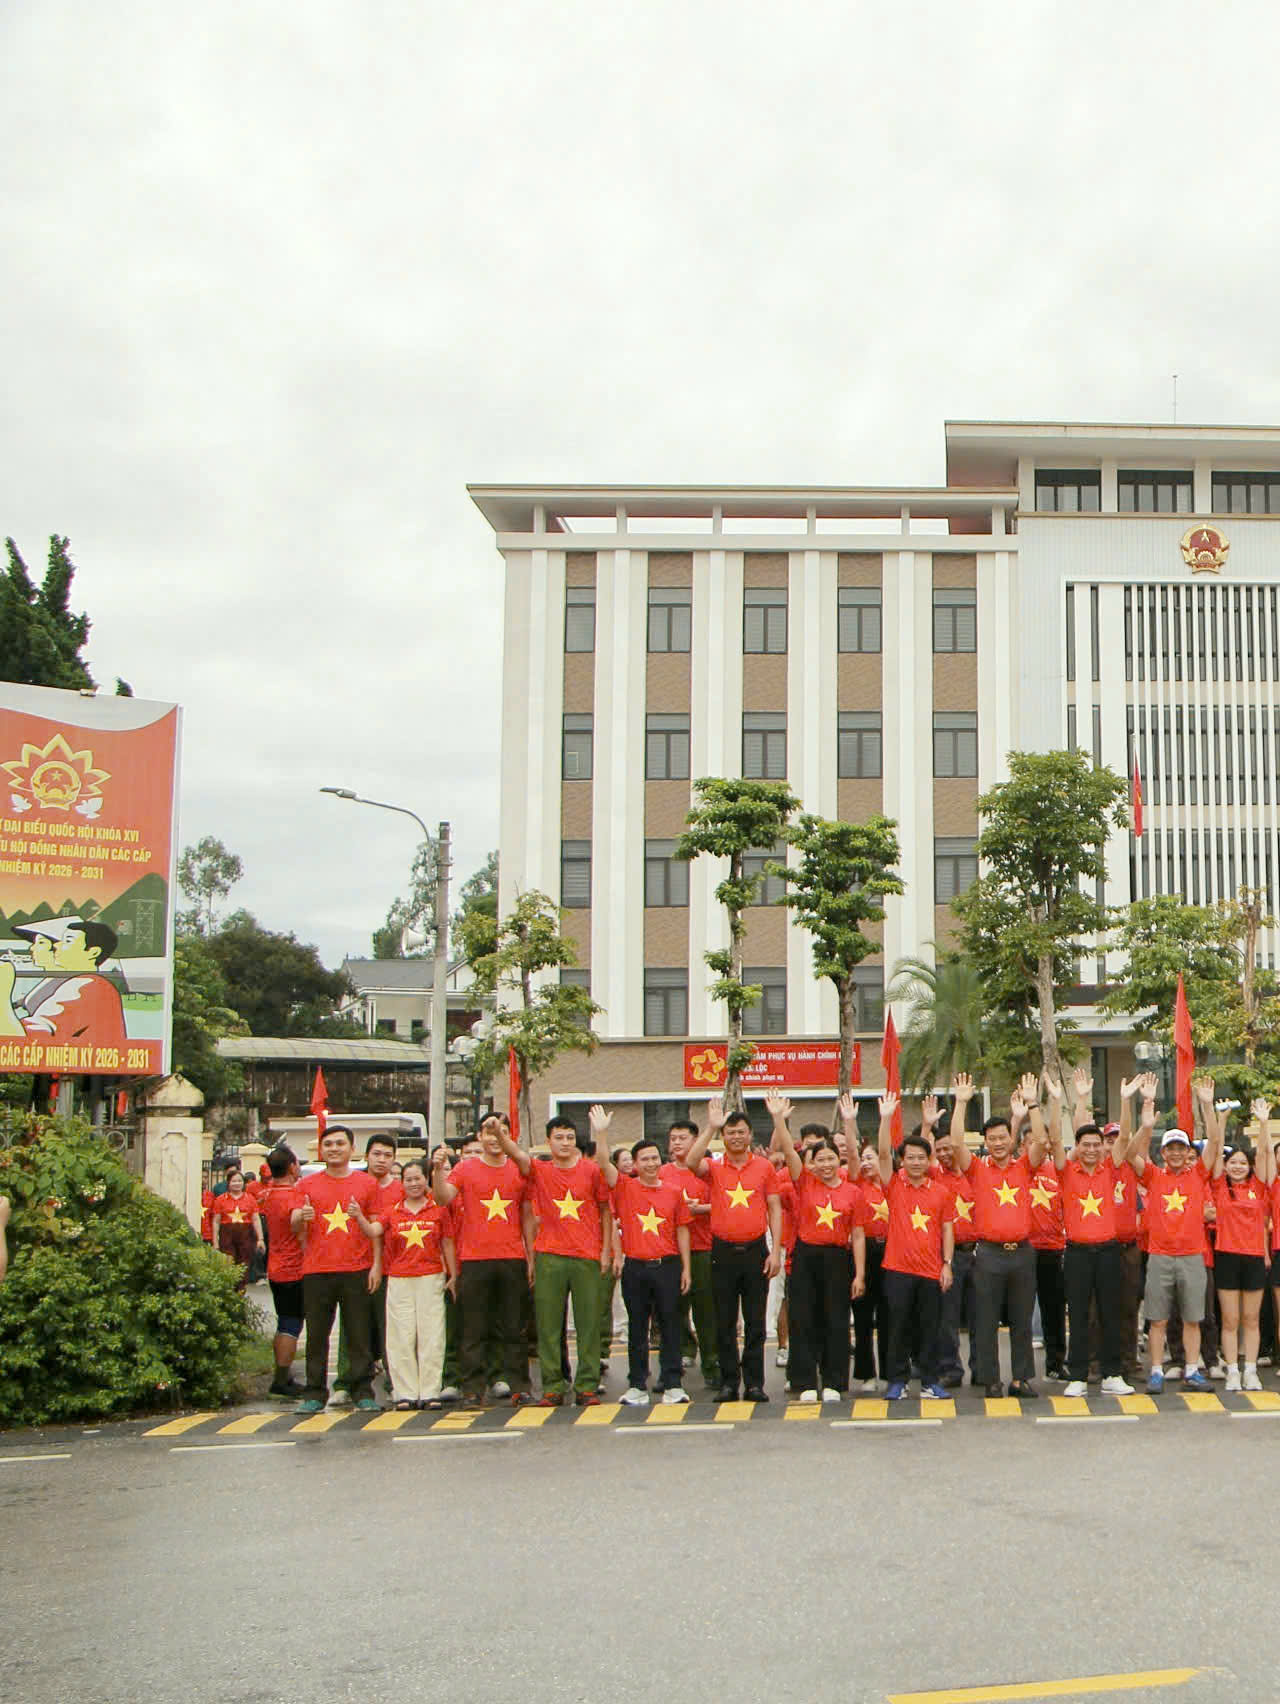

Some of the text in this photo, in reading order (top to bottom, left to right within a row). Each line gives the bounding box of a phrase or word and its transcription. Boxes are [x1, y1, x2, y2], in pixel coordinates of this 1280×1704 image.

[4, 819, 21, 835] ĐẠI
[24, 818, 47, 835] BIỂU
[49, 821, 75, 837] QUỐC
[78, 824, 94, 841] HỘI
[96, 826, 122, 841] KHÓA
[124, 830, 139, 842] XVI
[10, 839, 27, 856] HỘI
[30, 839, 57, 856] ĐỒNG
[60, 843, 87, 858] NHÂN
[89, 845, 109, 859] DÂN
[111, 846, 130, 861] CÁC
[132, 846, 152, 862] CẤP
[49, 864, 73, 877] 2026
[81, 866, 104, 879] 2031
[1, 1041, 20, 1066] CÁC
[23, 1040, 44, 1066] CẤP
[46, 1042, 78, 1071] NHIỆM
[95, 1047, 118, 1068] 2026
[127, 1048, 149, 1069] 2031
